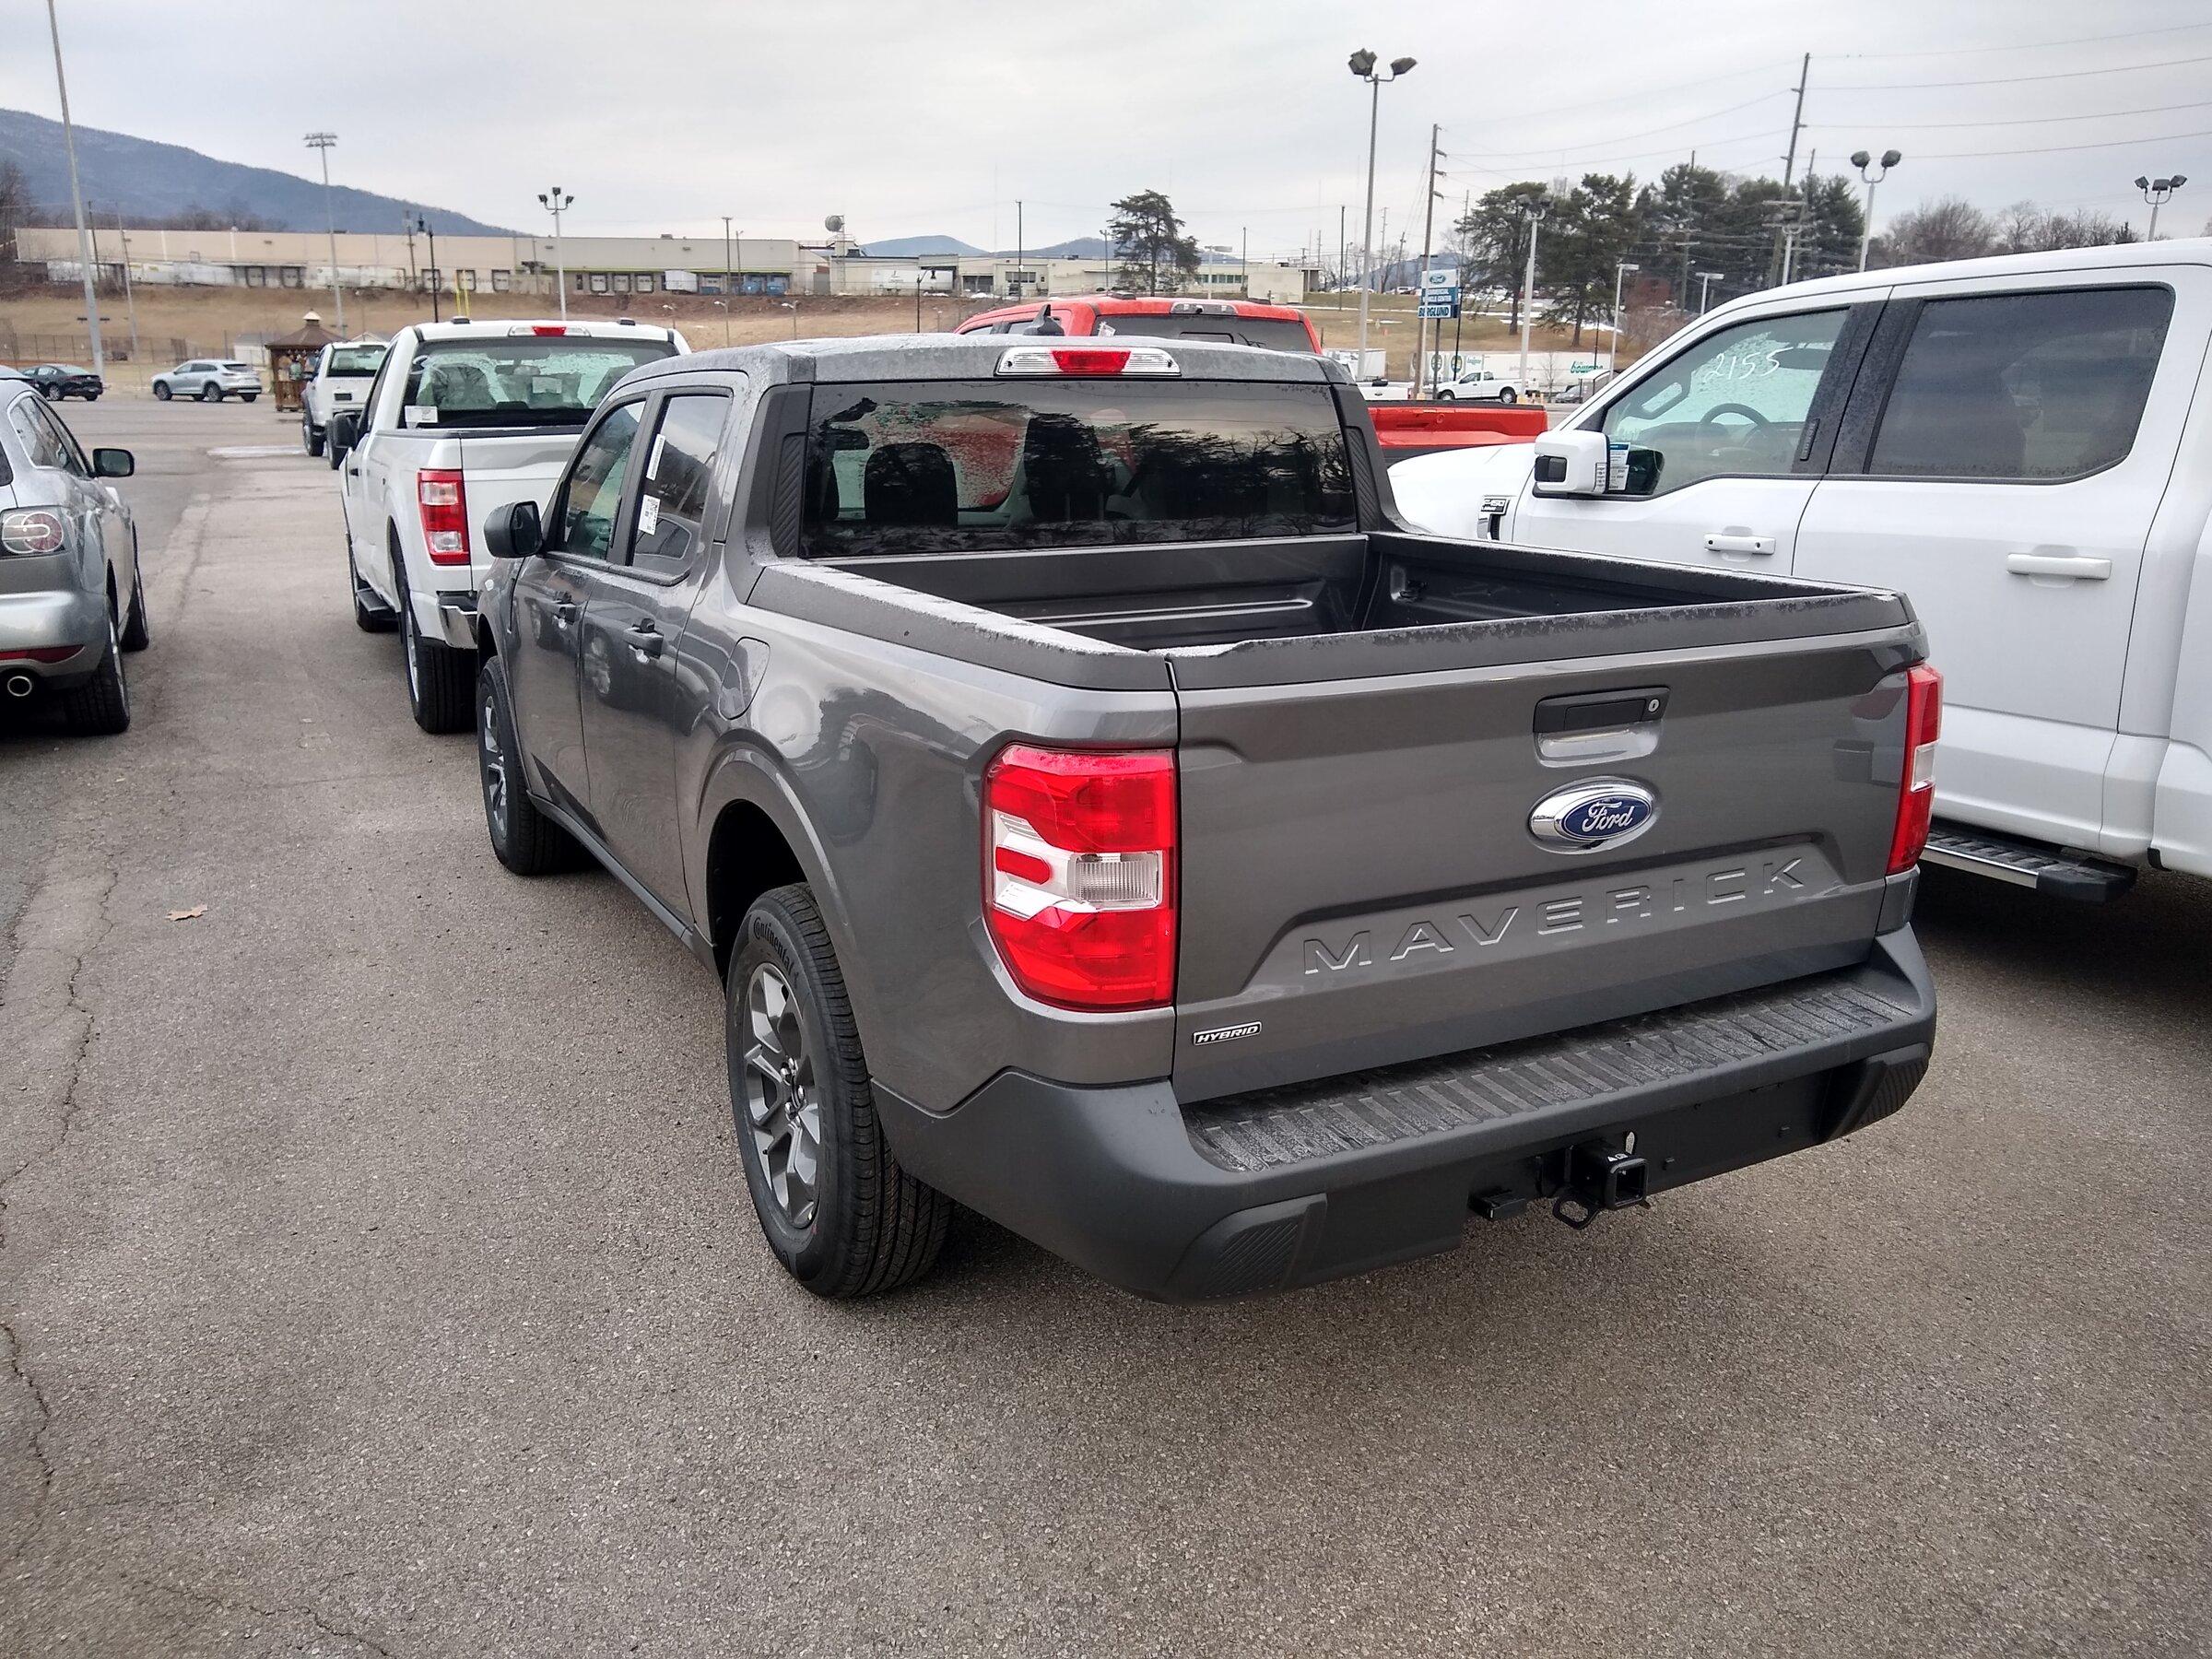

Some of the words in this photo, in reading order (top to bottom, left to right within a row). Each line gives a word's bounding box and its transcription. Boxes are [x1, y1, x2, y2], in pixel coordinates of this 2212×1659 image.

[1582, 800, 1635, 833] Ford
[1303, 857, 1805, 975] MAVERICK
[753, 916, 794, 977] Continental
[1196, 1026, 1260, 1043] HYBRID
